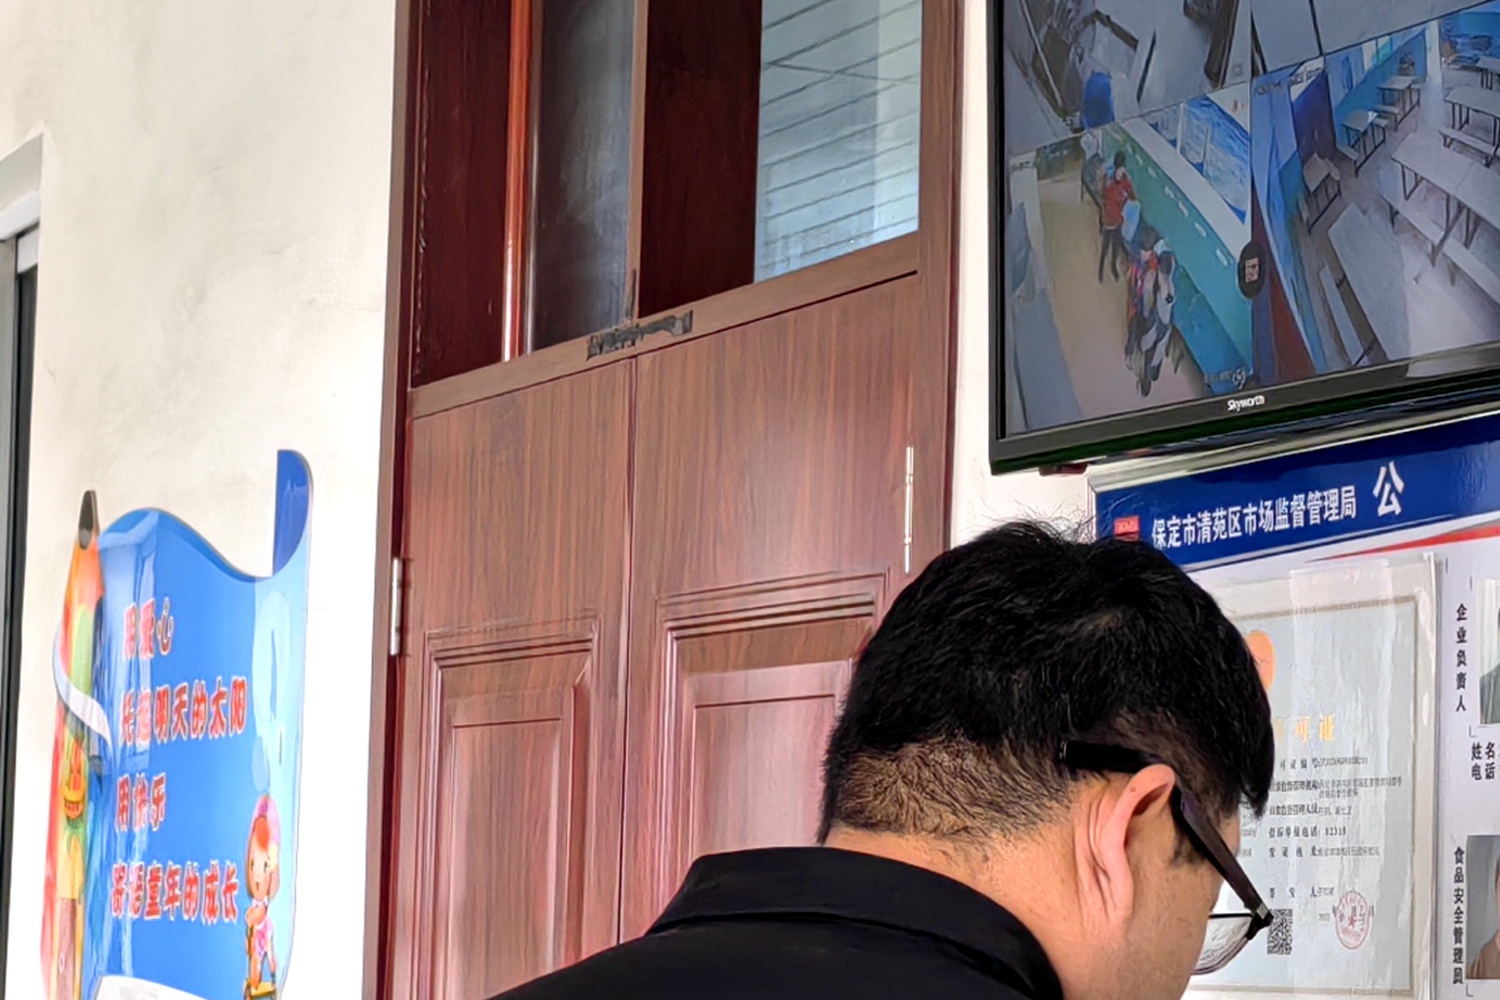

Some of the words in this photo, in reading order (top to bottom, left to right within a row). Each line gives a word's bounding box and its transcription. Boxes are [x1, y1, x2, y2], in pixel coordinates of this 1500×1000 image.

[1227, 394, 1265, 412] Skyworth
[1151, 485, 1357, 549] 保定市清苑区市场监督管理局
[1455, 603, 1468, 712] 企业负责人
[119, 675, 248, 747] 托起明天的太阳
[115, 772, 167, 832] 用快乐
[1452, 846, 1465, 985] 食品安全管理员
